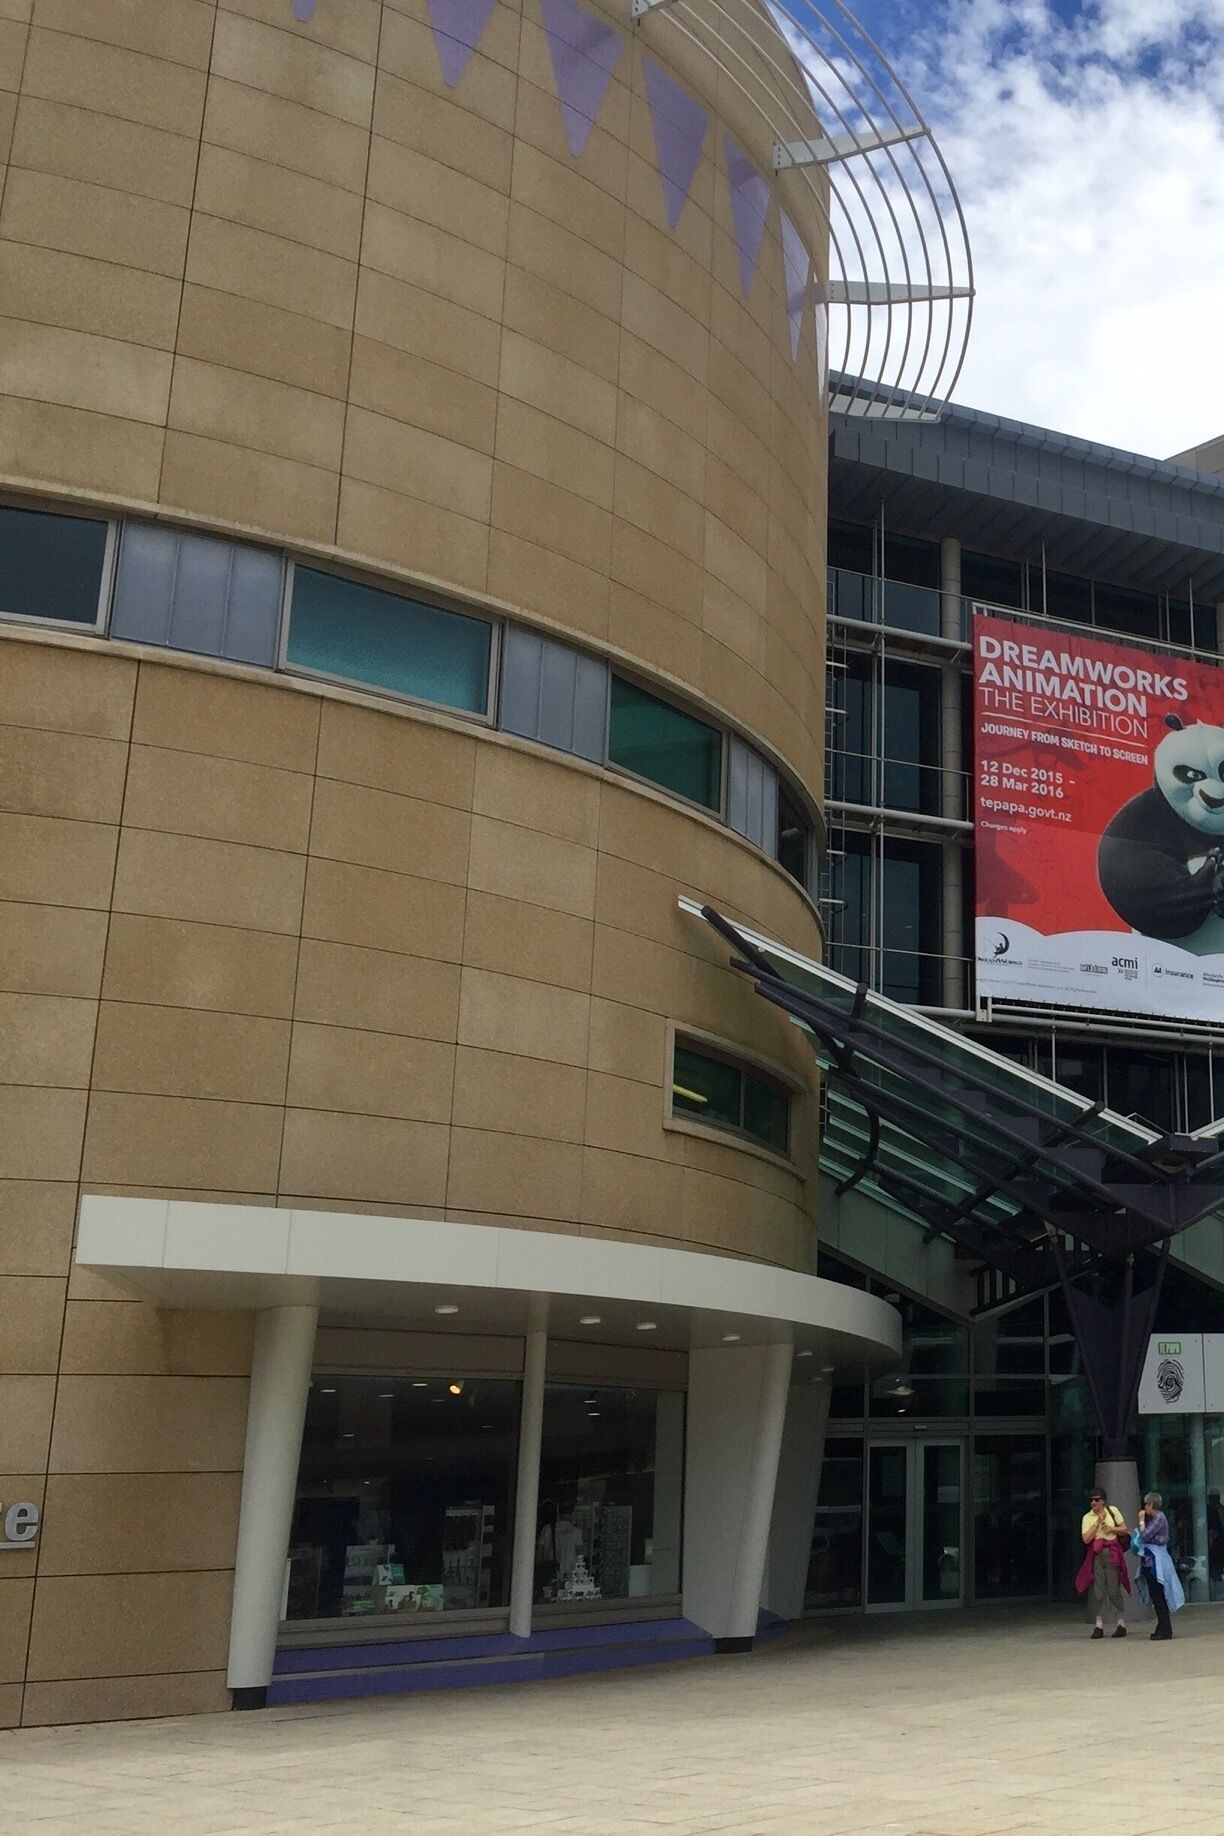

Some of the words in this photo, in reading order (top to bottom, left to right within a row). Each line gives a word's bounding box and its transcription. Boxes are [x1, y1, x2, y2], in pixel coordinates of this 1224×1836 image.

[979, 636, 1189, 700] DREAMWORKS
[979, 663, 1147, 717] ANIMATION
[979, 687, 1024, 712] THE
[1031, 696, 1148, 739] EXHIBITION
[981, 723, 1029, 741] JOURNEY
[1031, 732, 1060, 747] FROM
[1061, 737, 1098, 755] SKETCH
[1099, 745, 1111, 757] TO
[1113, 748, 1148, 765] SCREEN
[981, 760, 999, 773] 12
[1002, 763, 1028, 778] Dec
[1030, 768, 1063, 784] 2015
[981, 774, 999, 788] 28
[1002, 777, 1028, 792] Mar
[1031, 782, 1064, 799] 2016
[980, 796, 1072, 822] tepapa.govt.nz
[1111, 955, 1138, 970] acmi
[0, 1502, 39, 1541] e
